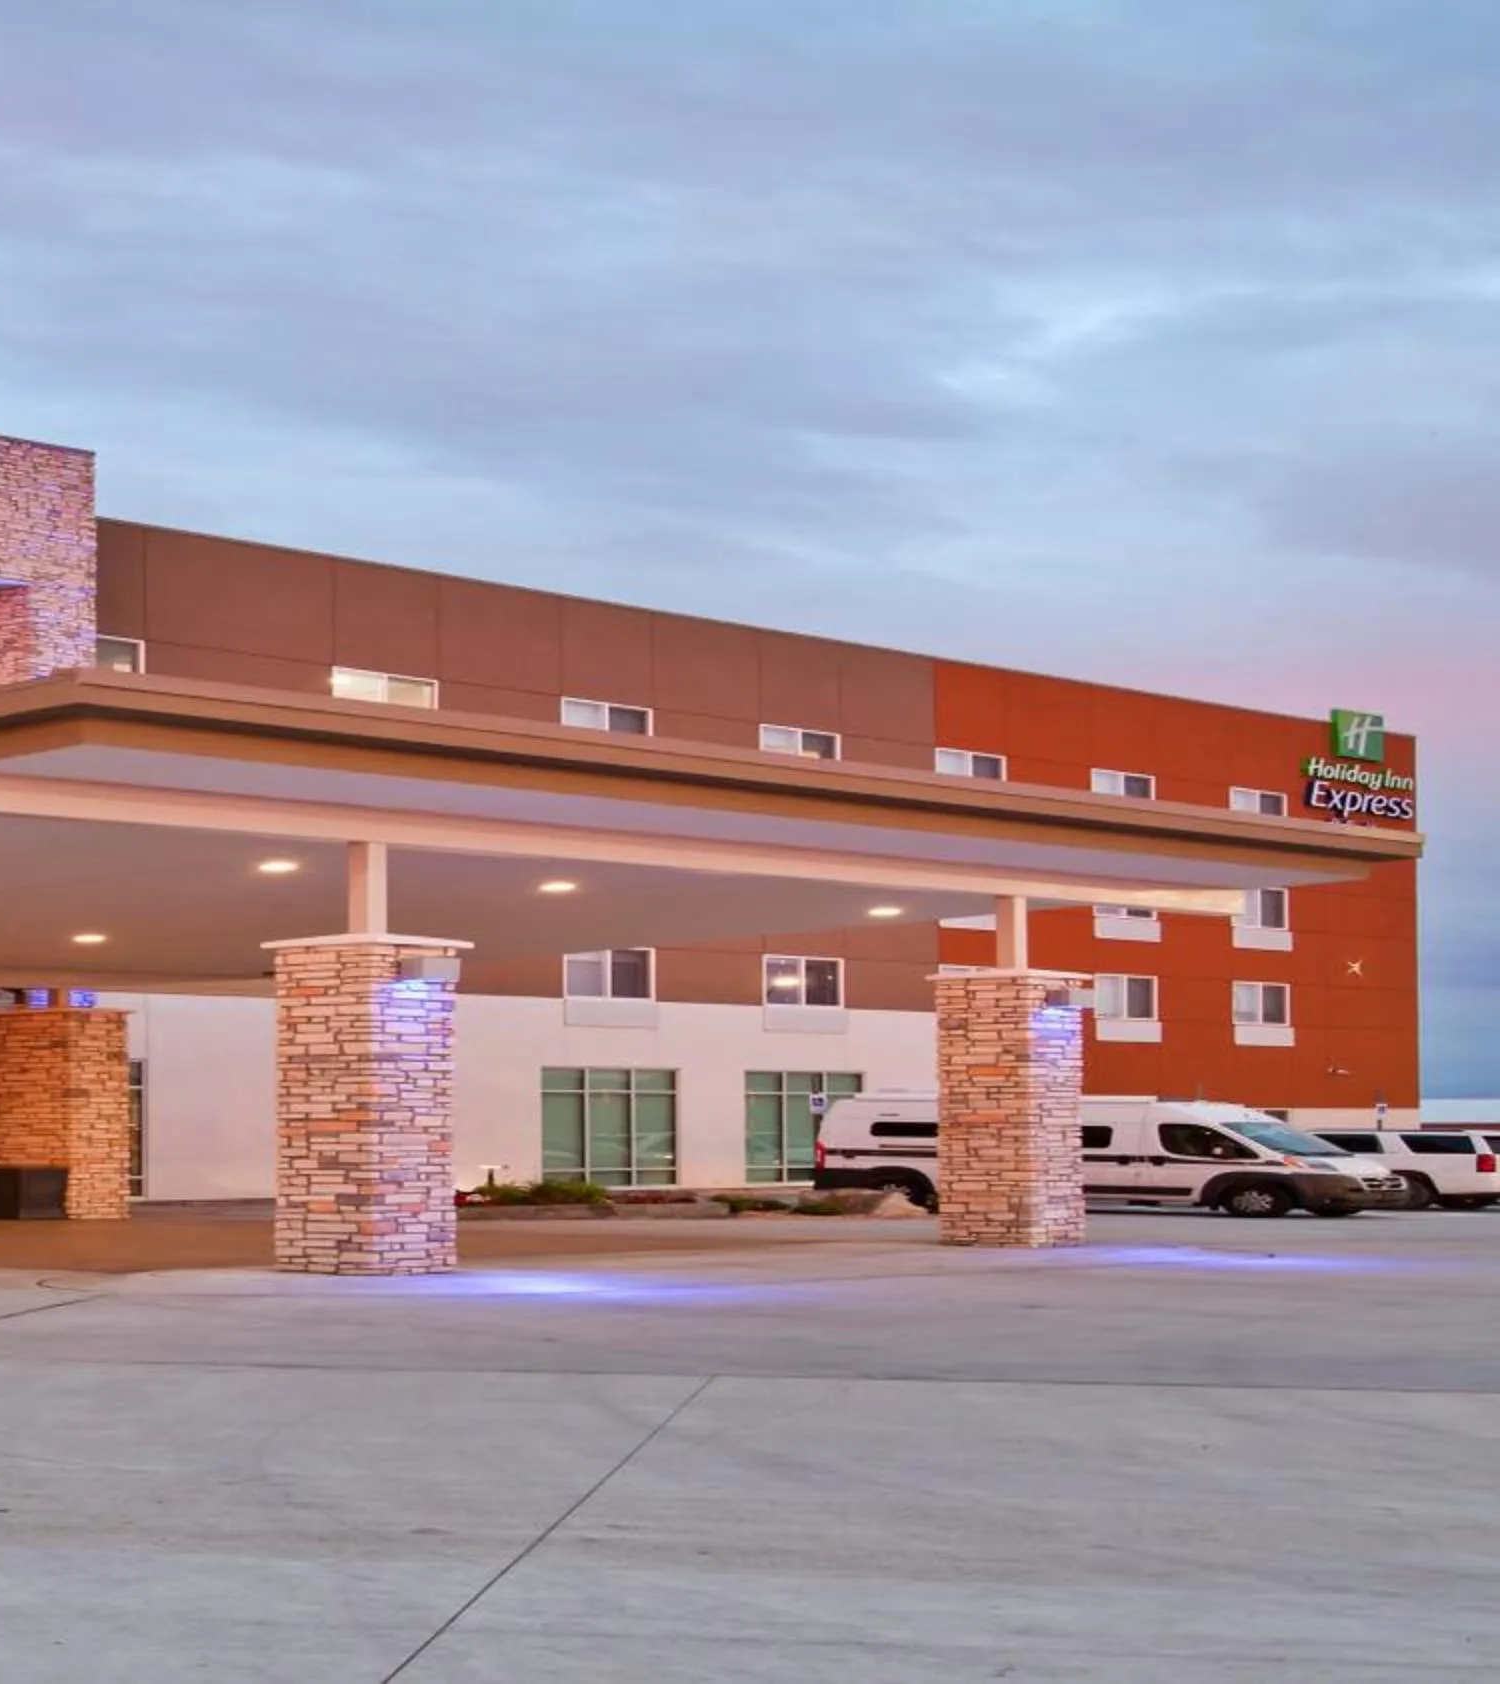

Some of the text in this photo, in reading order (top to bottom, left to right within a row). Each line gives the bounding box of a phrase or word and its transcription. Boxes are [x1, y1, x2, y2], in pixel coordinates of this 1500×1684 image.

[1307, 756, 1414, 791] Holiday Inn
[1309, 780, 1414, 819] Express
